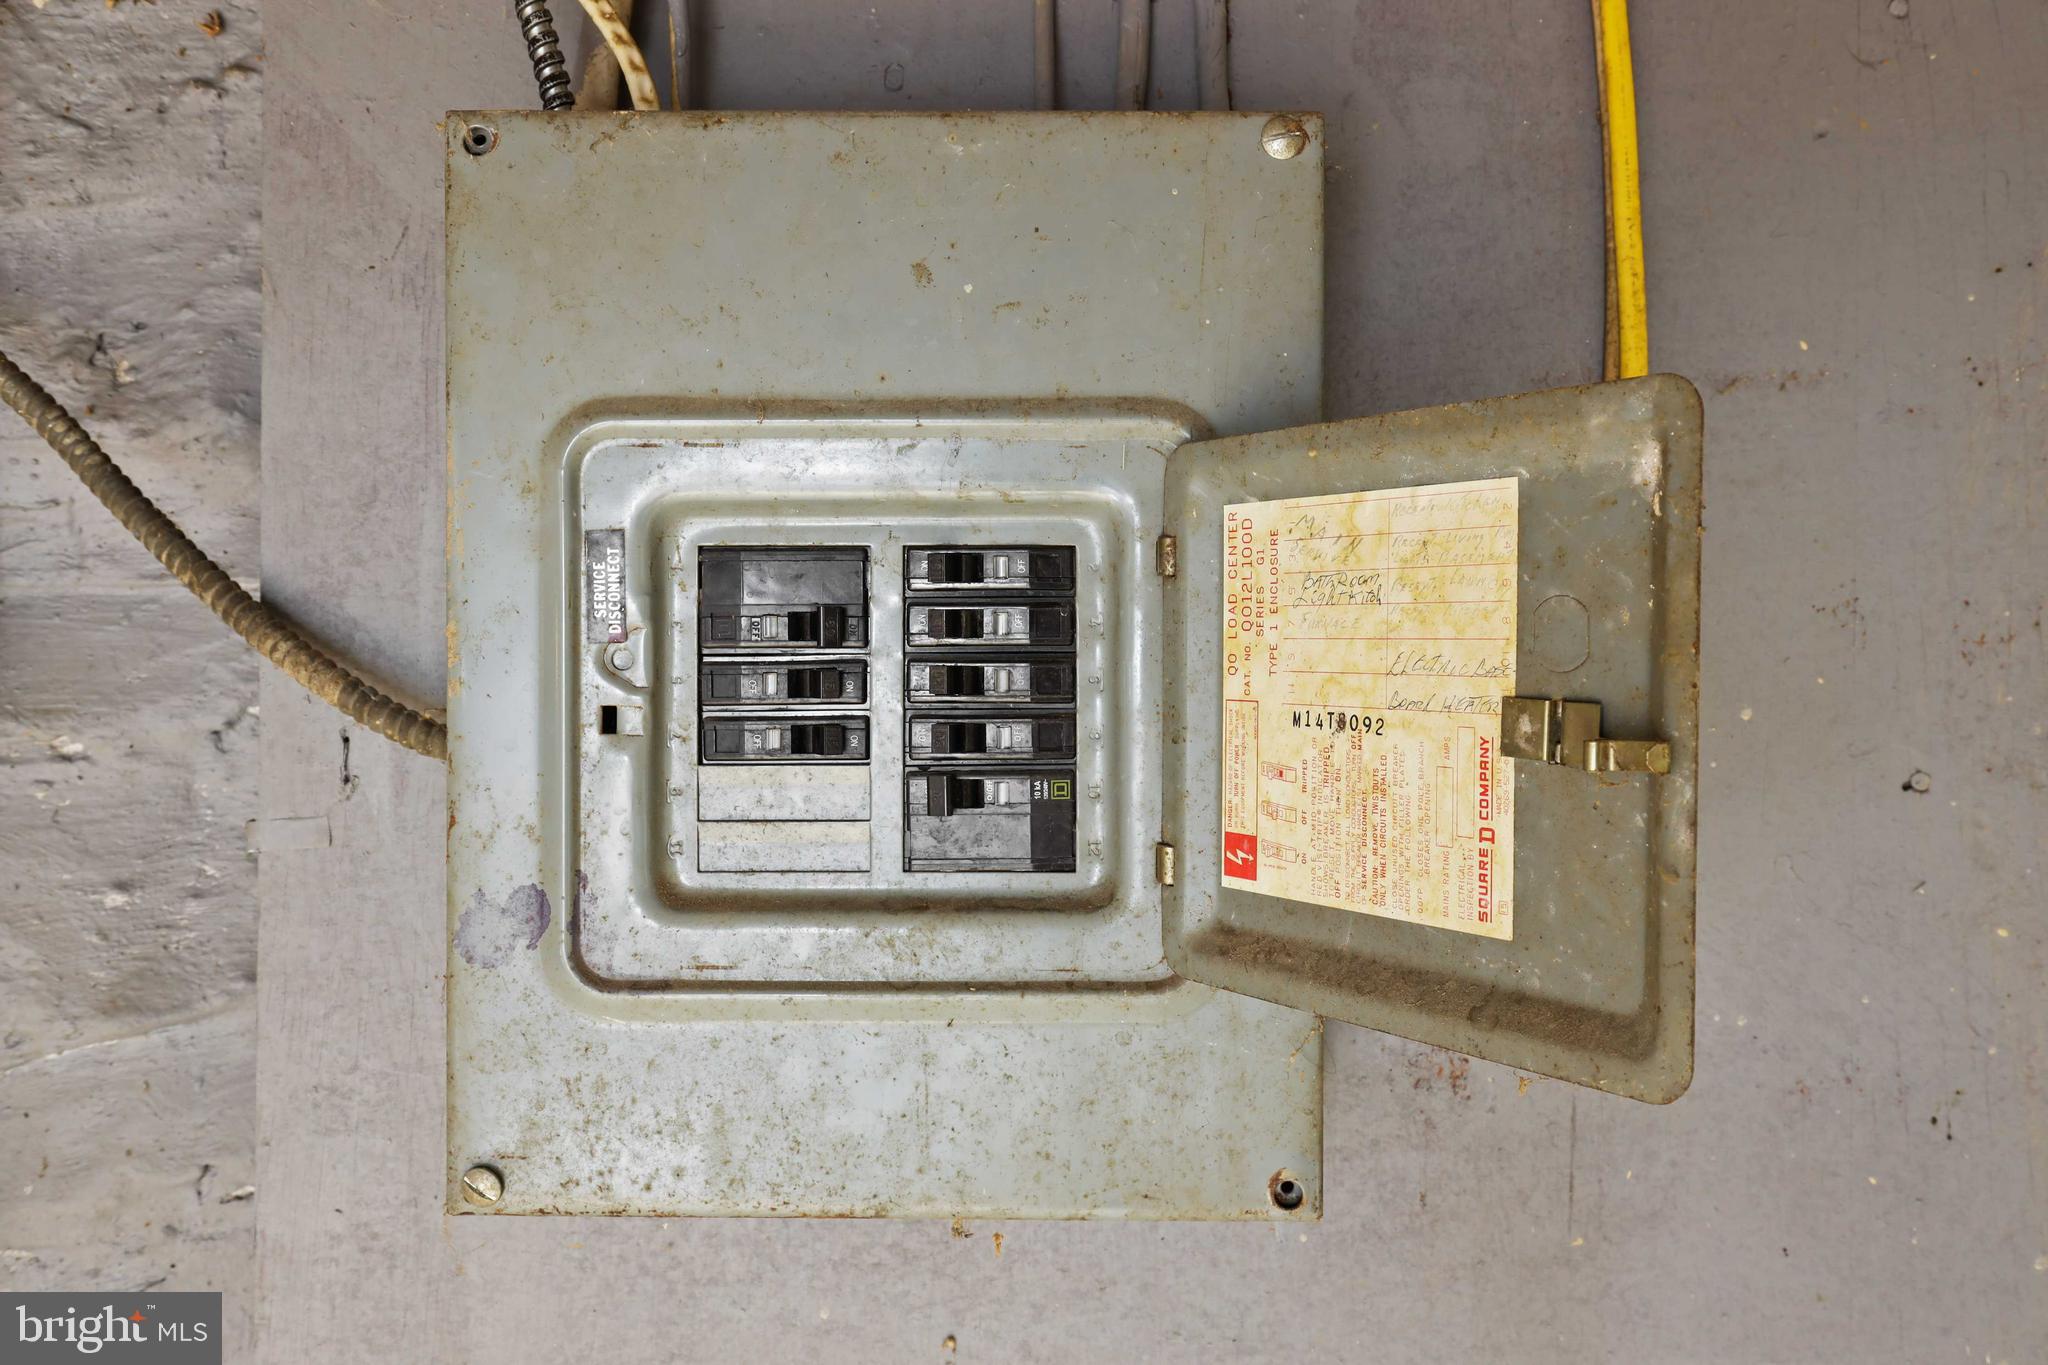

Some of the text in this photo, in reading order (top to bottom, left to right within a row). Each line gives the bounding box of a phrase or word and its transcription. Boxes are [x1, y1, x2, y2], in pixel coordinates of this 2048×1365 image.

[1503, 503, 1512, 511] 2
[920, 560, 928, 572] ON
[1017, 558, 1026, 574] OFF
[1269, 528, 1278, 614] ENCLOSURE
[1241, 518, 1253, 632] QO12L100D
[593, 561, 607, 618] SERVICE
[607, 546, 622, 634] DISCONNECT
[1228, 512, 1238, 676] QO LOAD CENTER
[1256, 549, 1264, 637] SERIES G1
[1288, 586, 1296, 595] 5
[1014, 613, 1023, 628] OFF
[1502, 616, 1511, 625] 8
[751, 619, 761, 641] OFF
[1269, 643, 1278, 677] TYPE
[1288, 653, 1296, 661] 9
[748, 680, 758, 694] OFF
[846, 680, 854, 693] ON
[850, 734, 859, 748] ON
[1014, 725, 1023, 742] OFF
[753, 734, 762, 749] OFF
[1311, 736, 1317, 750] OR
[1443, 736, 1451, 761] AMPS
[1496, 779, 1502, 788] IN
[1033, 790, 1041, 800] 10
[1322, 794, 1329, 804] IS
[1478, 736, 1495, 923] SQUARE D COMPANY
[1301, 852, 1307, 865] ON
[1442, 851, 1450, 885] RATING
[1334, 880, 1342, 899] OFF
[1466, 847, 1474, 921] INSPECTION BY
